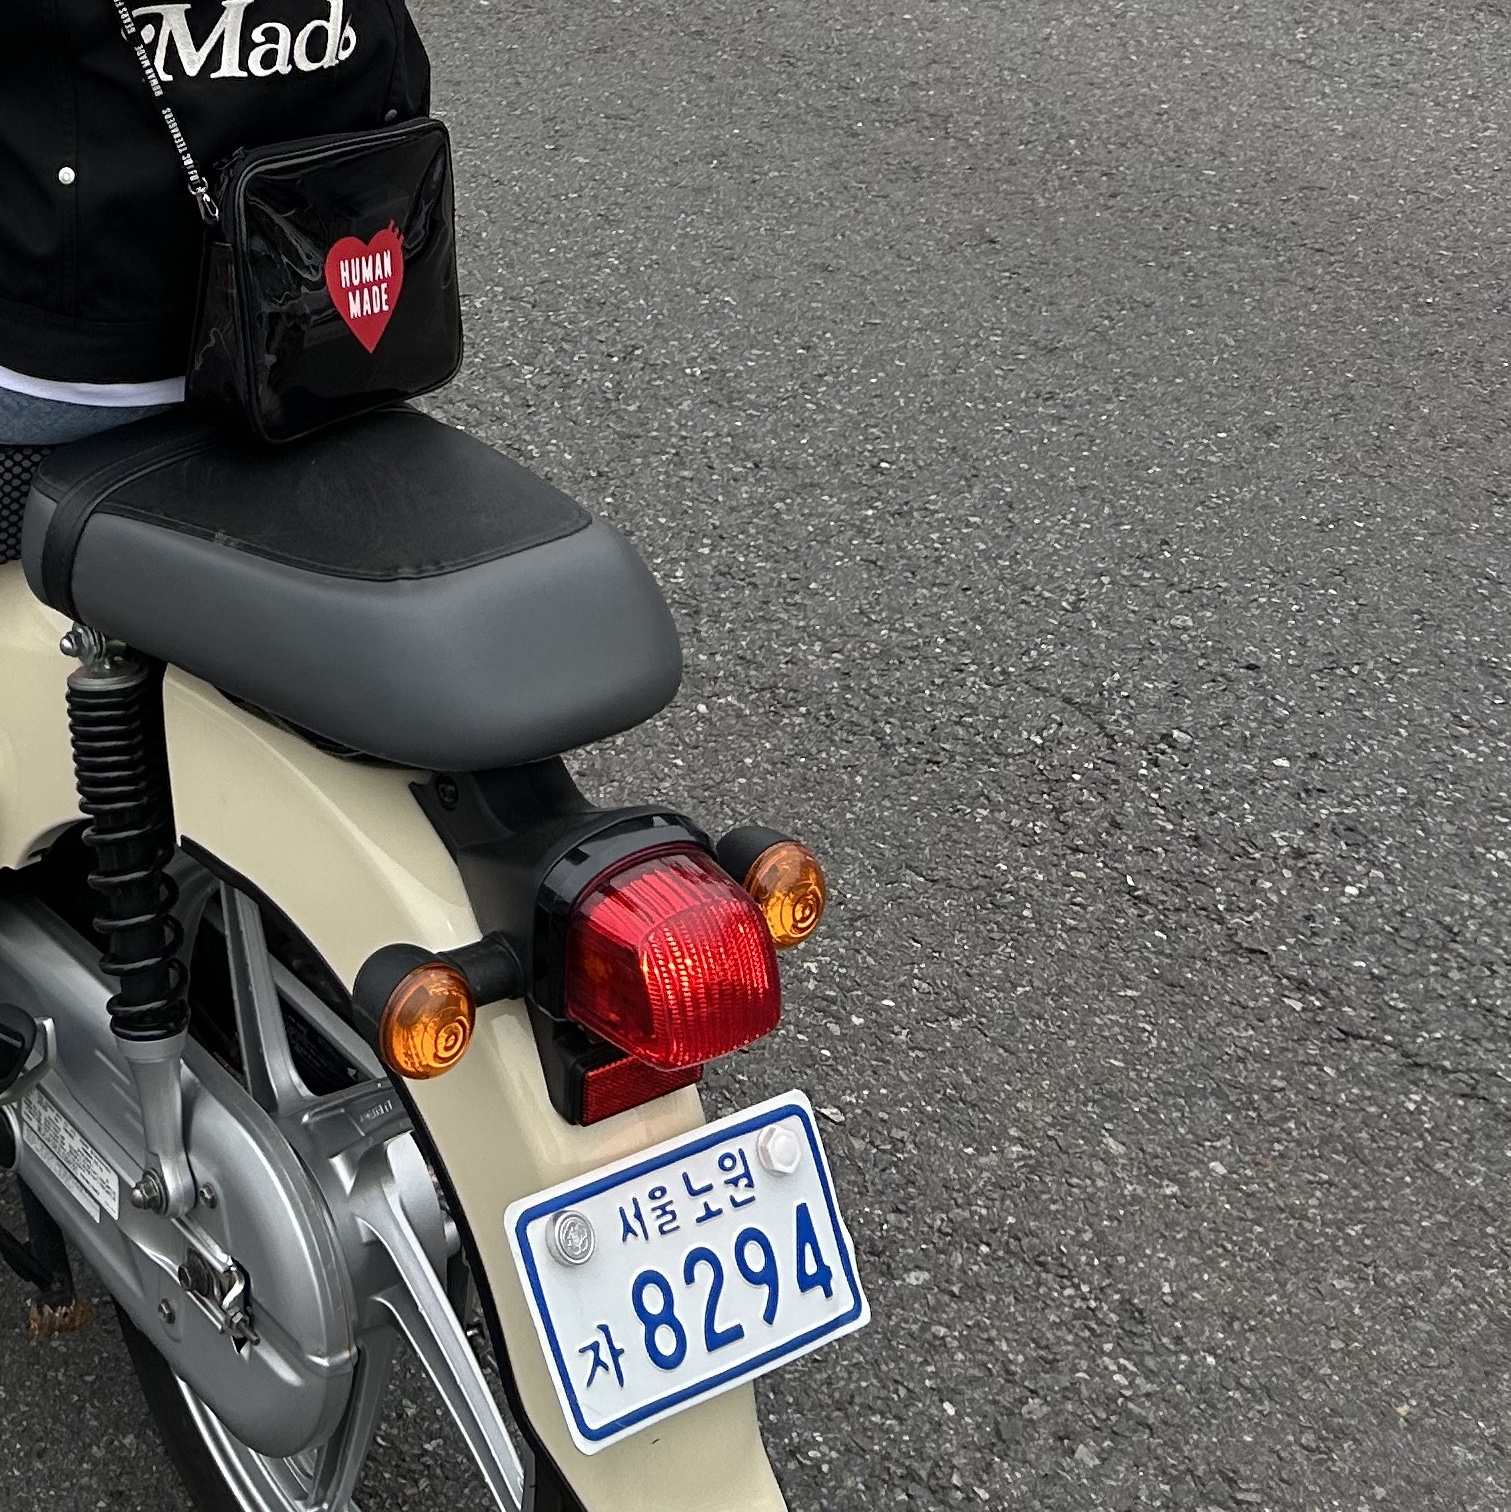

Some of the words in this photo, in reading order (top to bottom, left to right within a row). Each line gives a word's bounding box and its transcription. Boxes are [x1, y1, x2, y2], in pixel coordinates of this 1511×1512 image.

[339, 249, 393, 289] HUMAN
[347, 282, 390, 320] MADE
[631, 1201, 834, 1372] 8294
